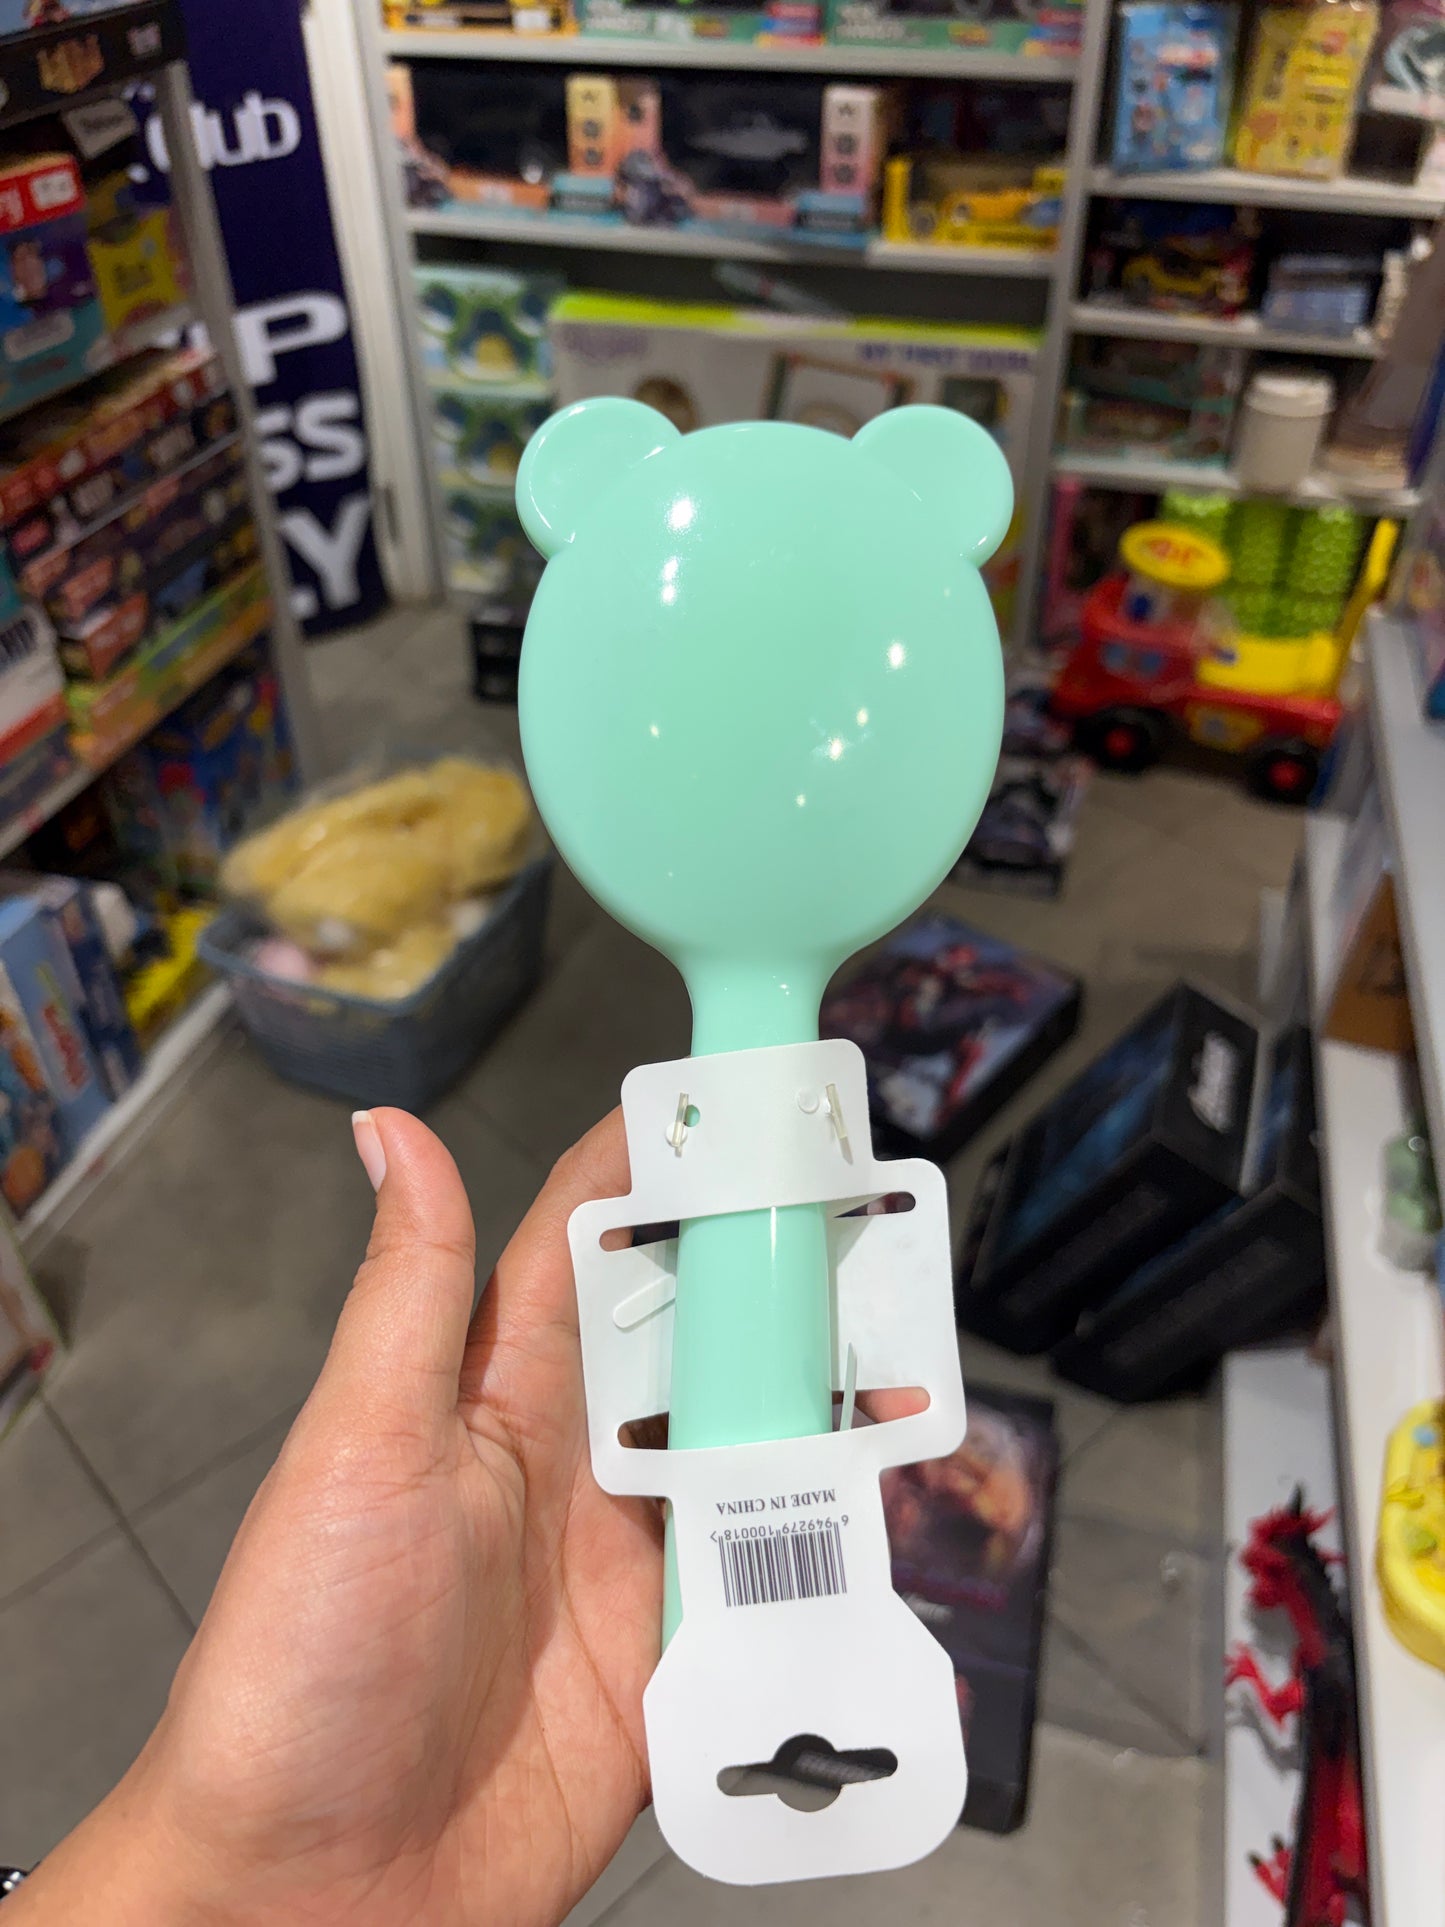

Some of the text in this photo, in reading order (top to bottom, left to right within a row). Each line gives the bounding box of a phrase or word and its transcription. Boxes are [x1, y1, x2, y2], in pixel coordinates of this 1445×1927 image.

[717, 1489, 836, 1516] MADE IN CHINA
